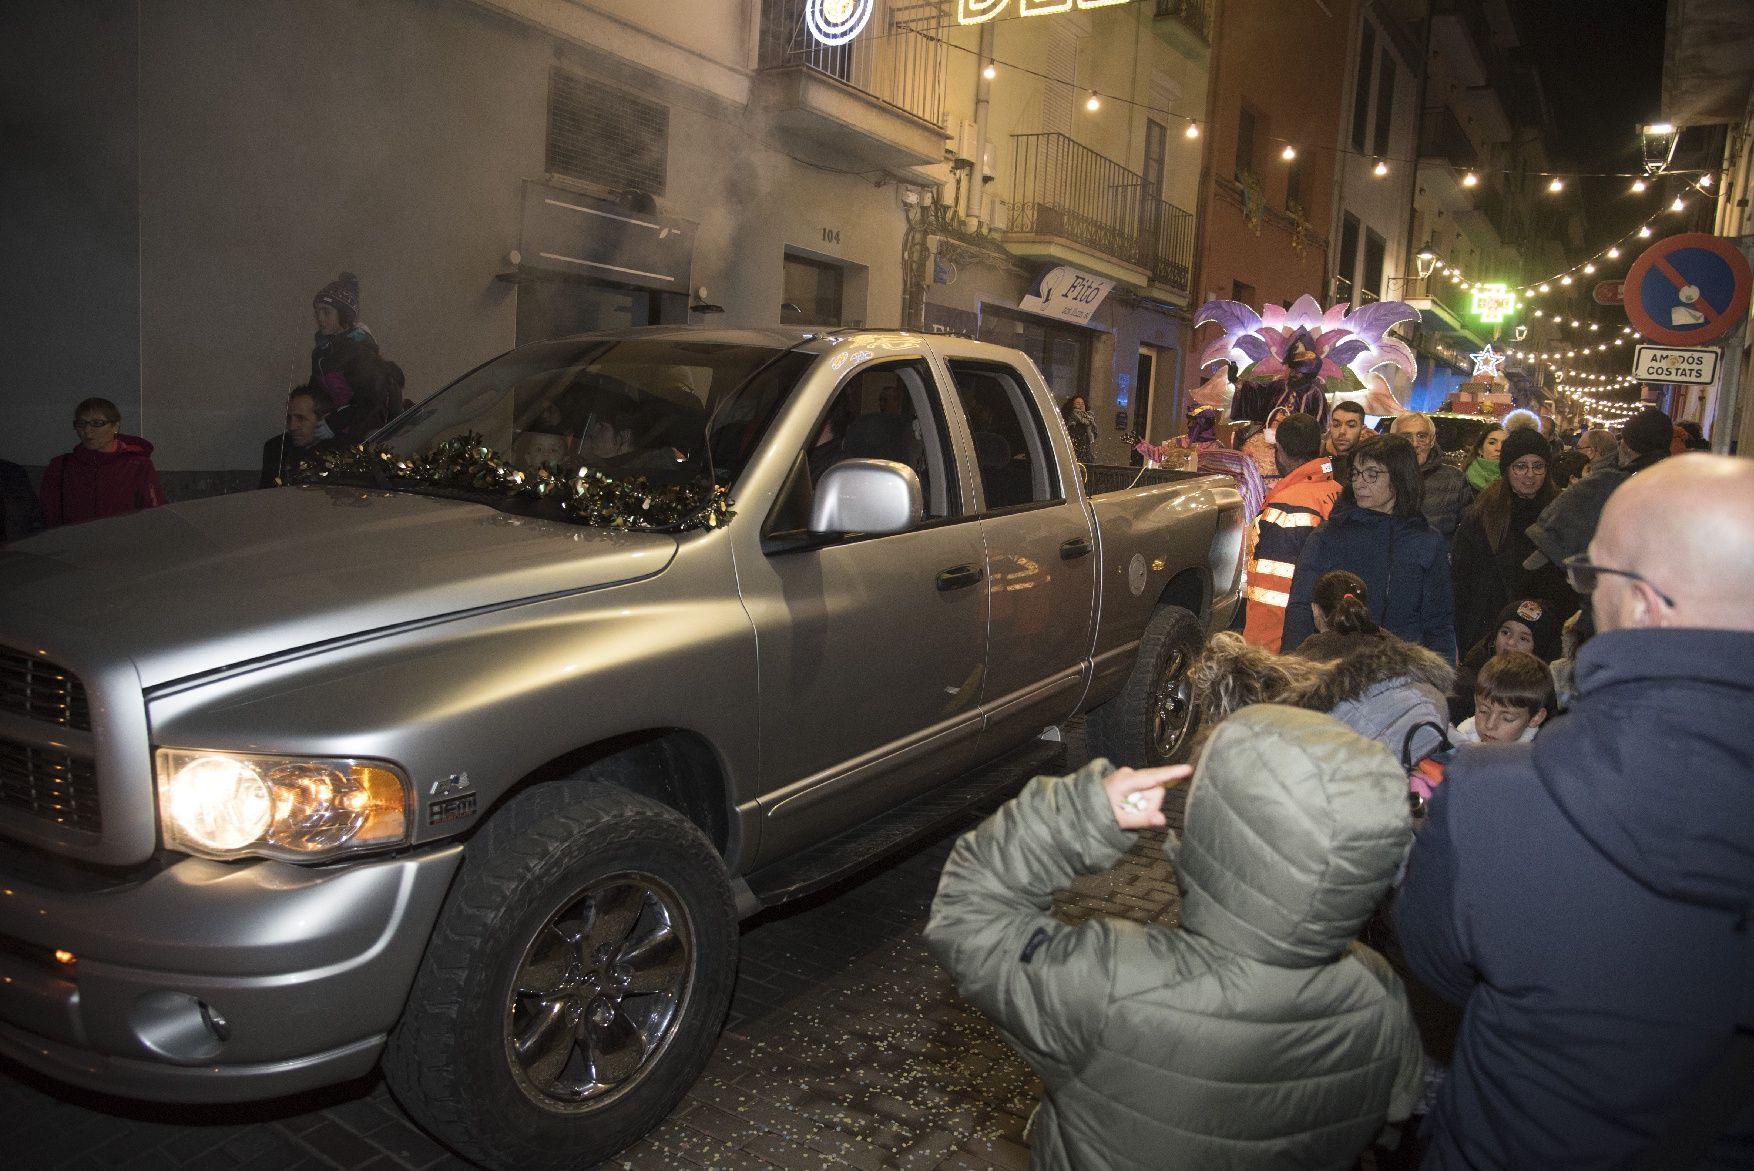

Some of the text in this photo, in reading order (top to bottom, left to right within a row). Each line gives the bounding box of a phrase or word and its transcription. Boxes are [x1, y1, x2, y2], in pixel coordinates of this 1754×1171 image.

[822, 227, 841, 245] 104
[1061, 274, 1105, 304] Fitó
[1650, 353, 1704, 366] AMDÓS
[1646, 366, 1703, 379] COSTATS
